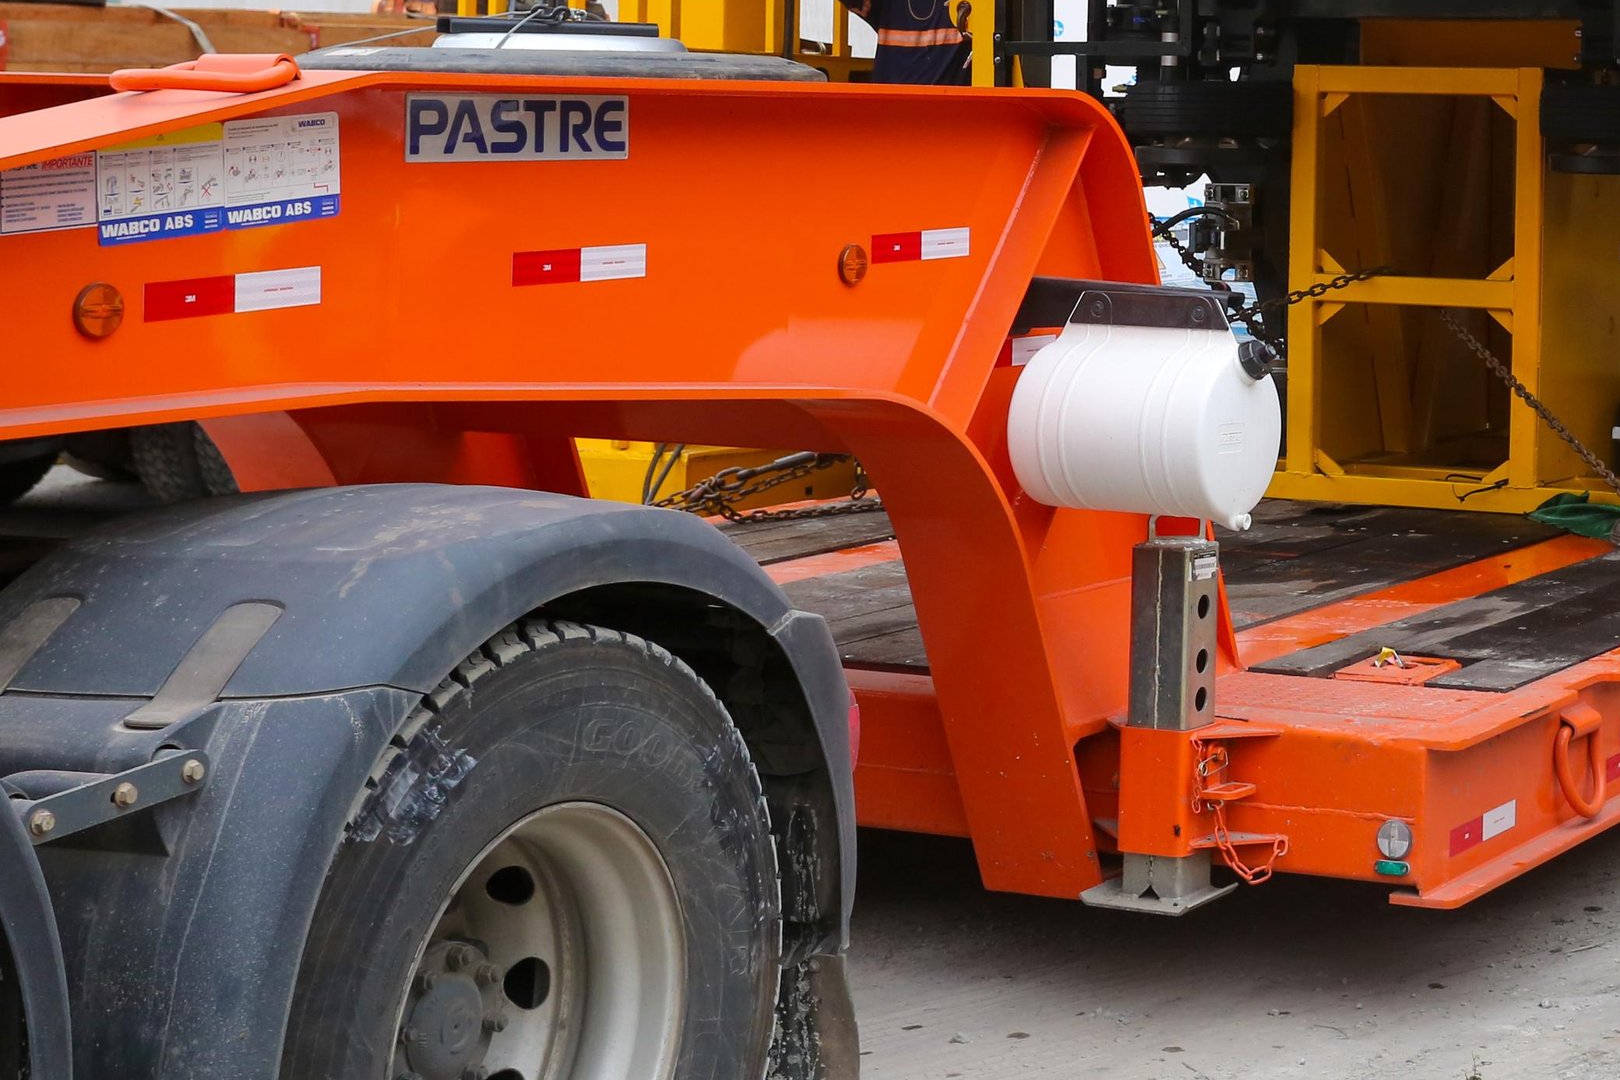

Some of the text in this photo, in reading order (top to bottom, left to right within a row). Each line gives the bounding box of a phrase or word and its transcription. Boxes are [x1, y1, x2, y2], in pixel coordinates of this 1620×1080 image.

[298, 119, 326, 128] WABCO
[410, 99, 626, 155] PASTRE
[41, 156, 94, 171] IMPORTANTE
[228, 205, 281, 224] WABCO
[285, 201, 312, 217] ABS
[101, 219, 160, 239] WABCO
[164, 214, 194, 231] ABS
[184, 294, 196, 303] 3M
